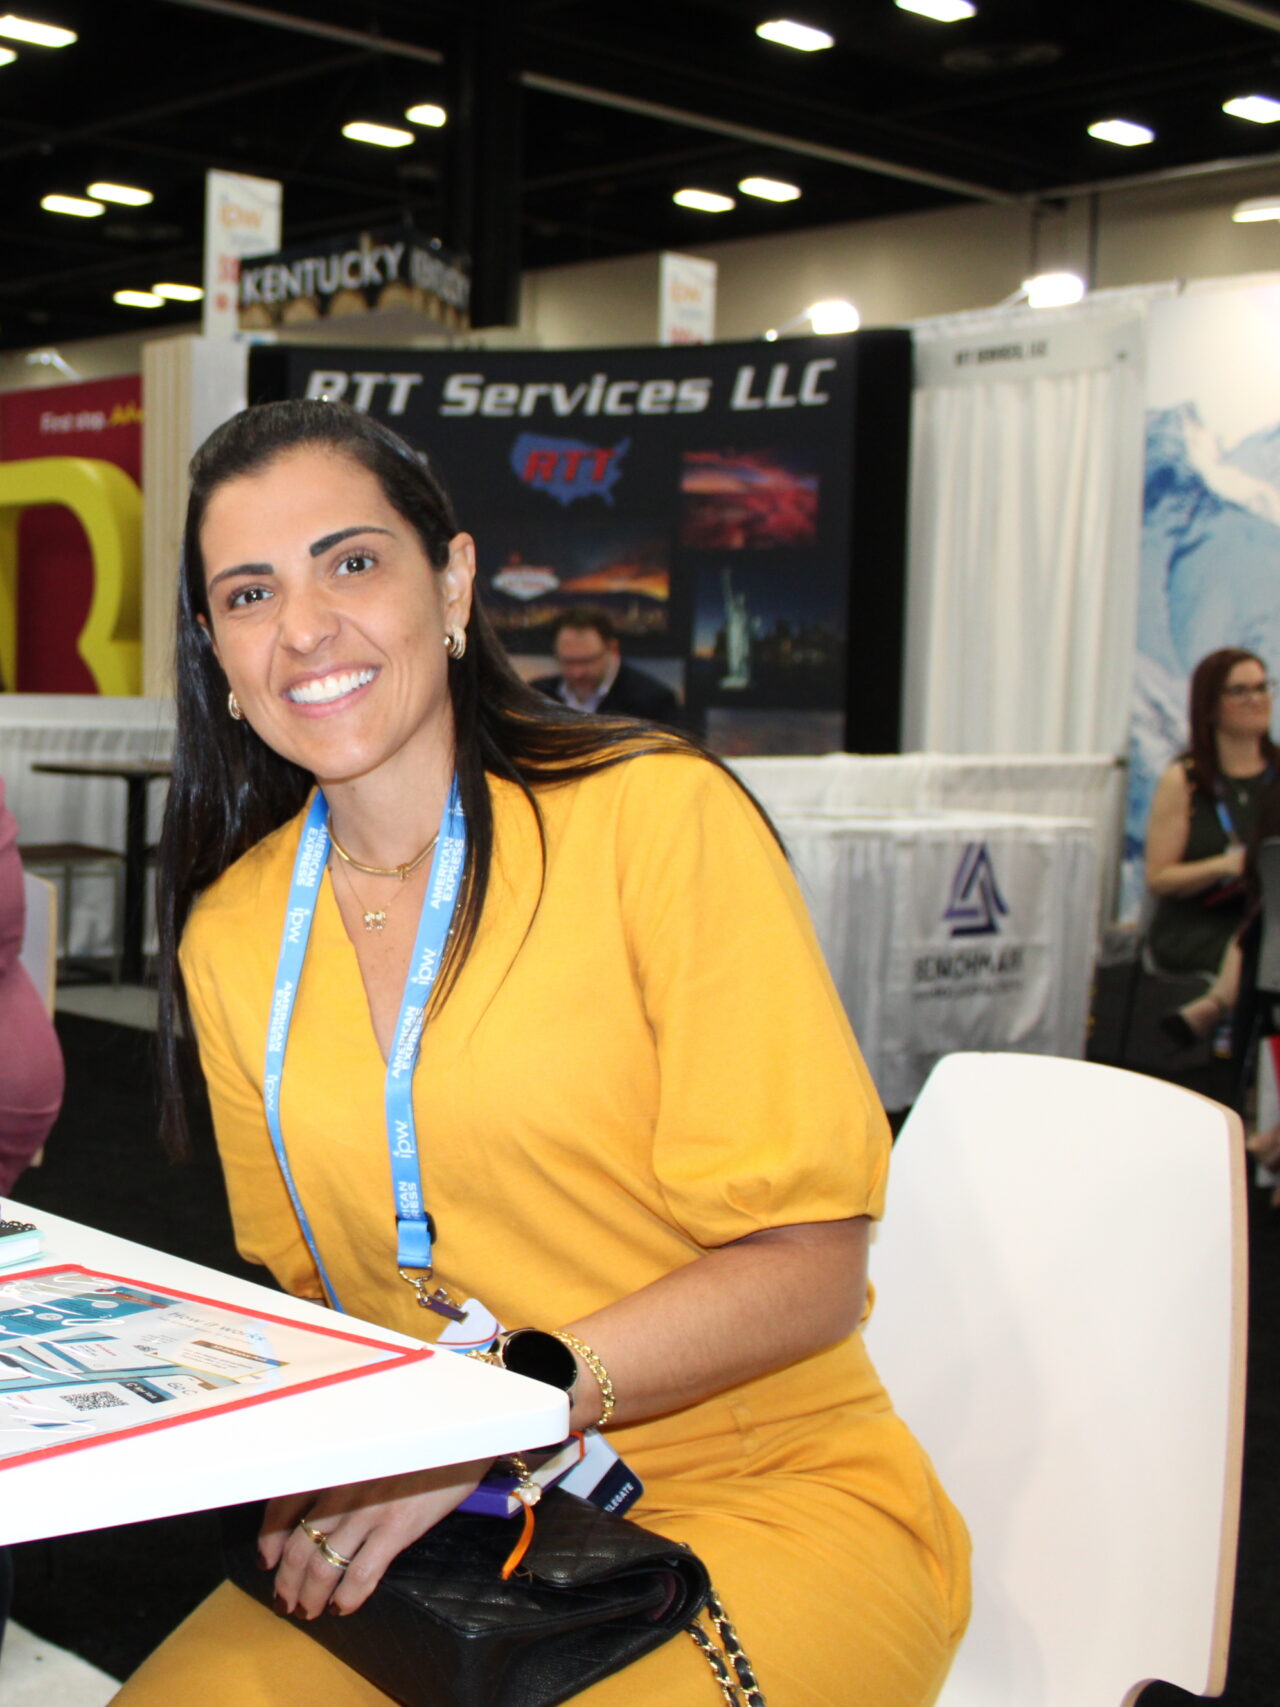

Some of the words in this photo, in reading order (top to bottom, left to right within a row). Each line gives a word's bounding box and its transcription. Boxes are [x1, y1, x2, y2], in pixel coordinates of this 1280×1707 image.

[241, 241, 404, 305] KENTUCKY
[304, 371, 422, 415] RTT
[440, 373, 712, 418] Services
[730, 359, 838, 411] LLC
[522, 448, 618, 483] RTT
[296, 826, 319, 888] EXPRESS
[307, 823, 329, 888] AMERICAN
[429, 836, 455, 910] AMERICAN
[442, 839, 465, 902] EXPRESS
[287, 907, 310, 944] ipw
[411, 947, 437, 986] ipw
[391, 1005, 418, 1079] AMERICAN
[402, 1007, 425, 1071] EXPRESS
[392, 1119, 417, 1159] ipw
